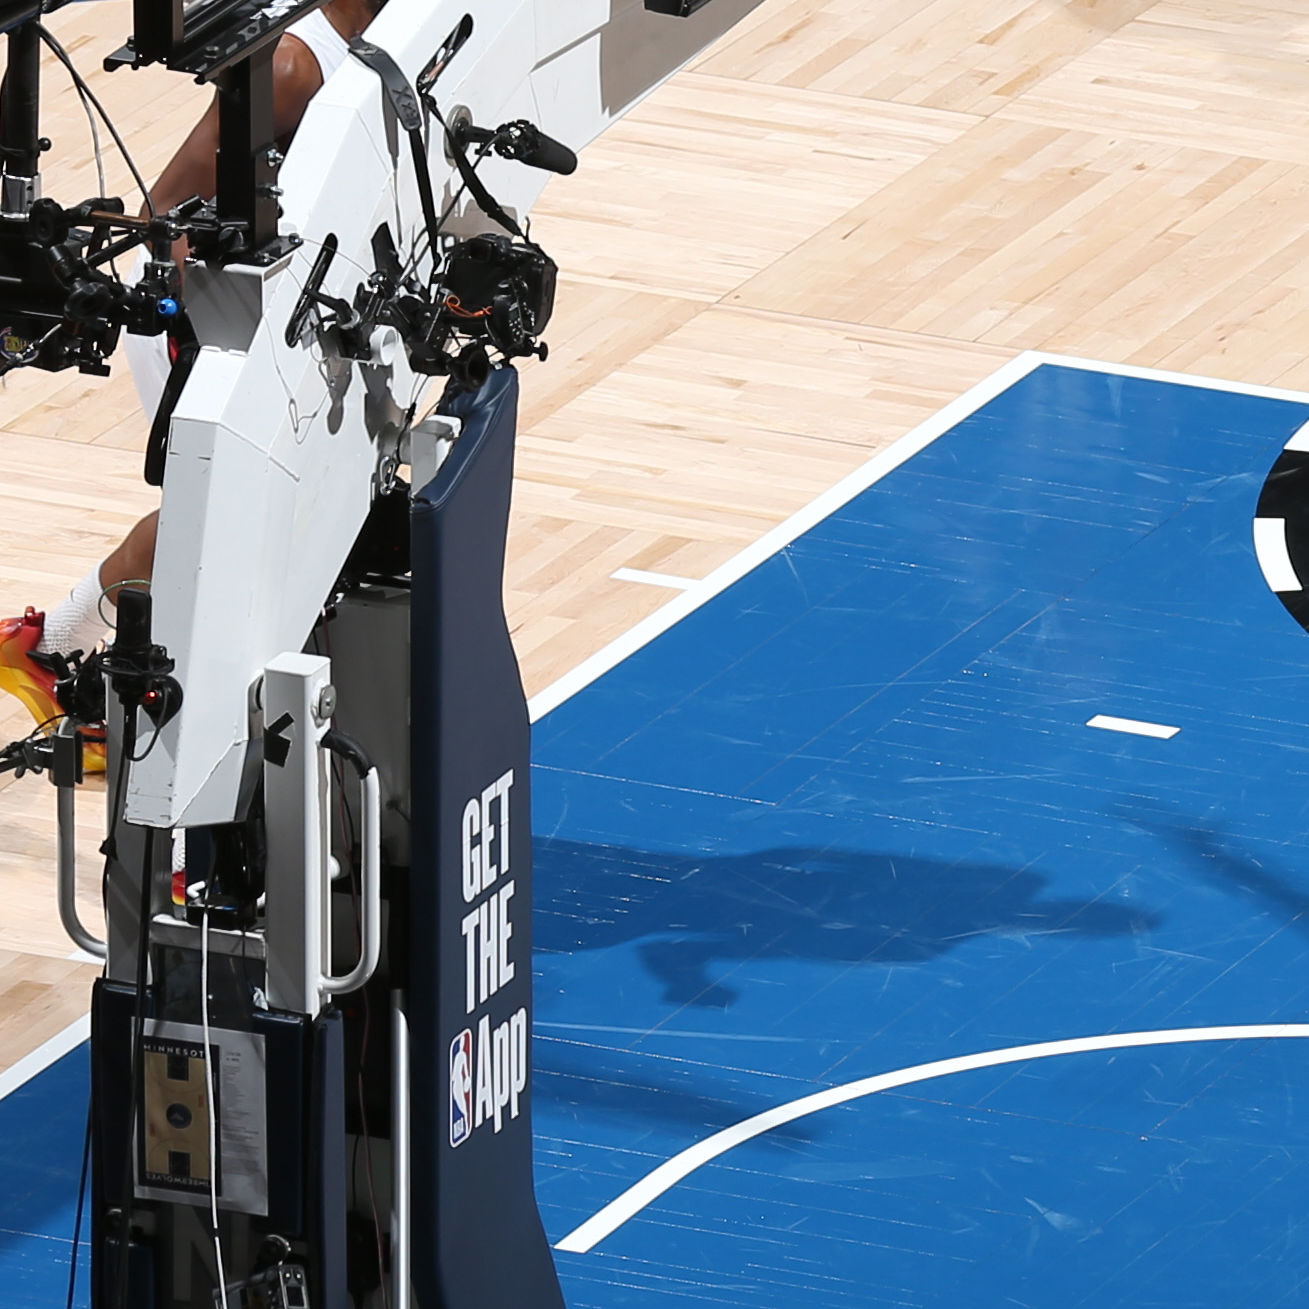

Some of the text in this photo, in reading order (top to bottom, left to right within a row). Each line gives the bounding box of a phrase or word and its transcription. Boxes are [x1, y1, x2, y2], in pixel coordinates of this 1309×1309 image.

[461, 768, 514, 904] GET
[461, 879, 516, 1015] THE
[143, 1044, 205, 1058] MINNESOT
[474, 1006, 528, 1134] App
